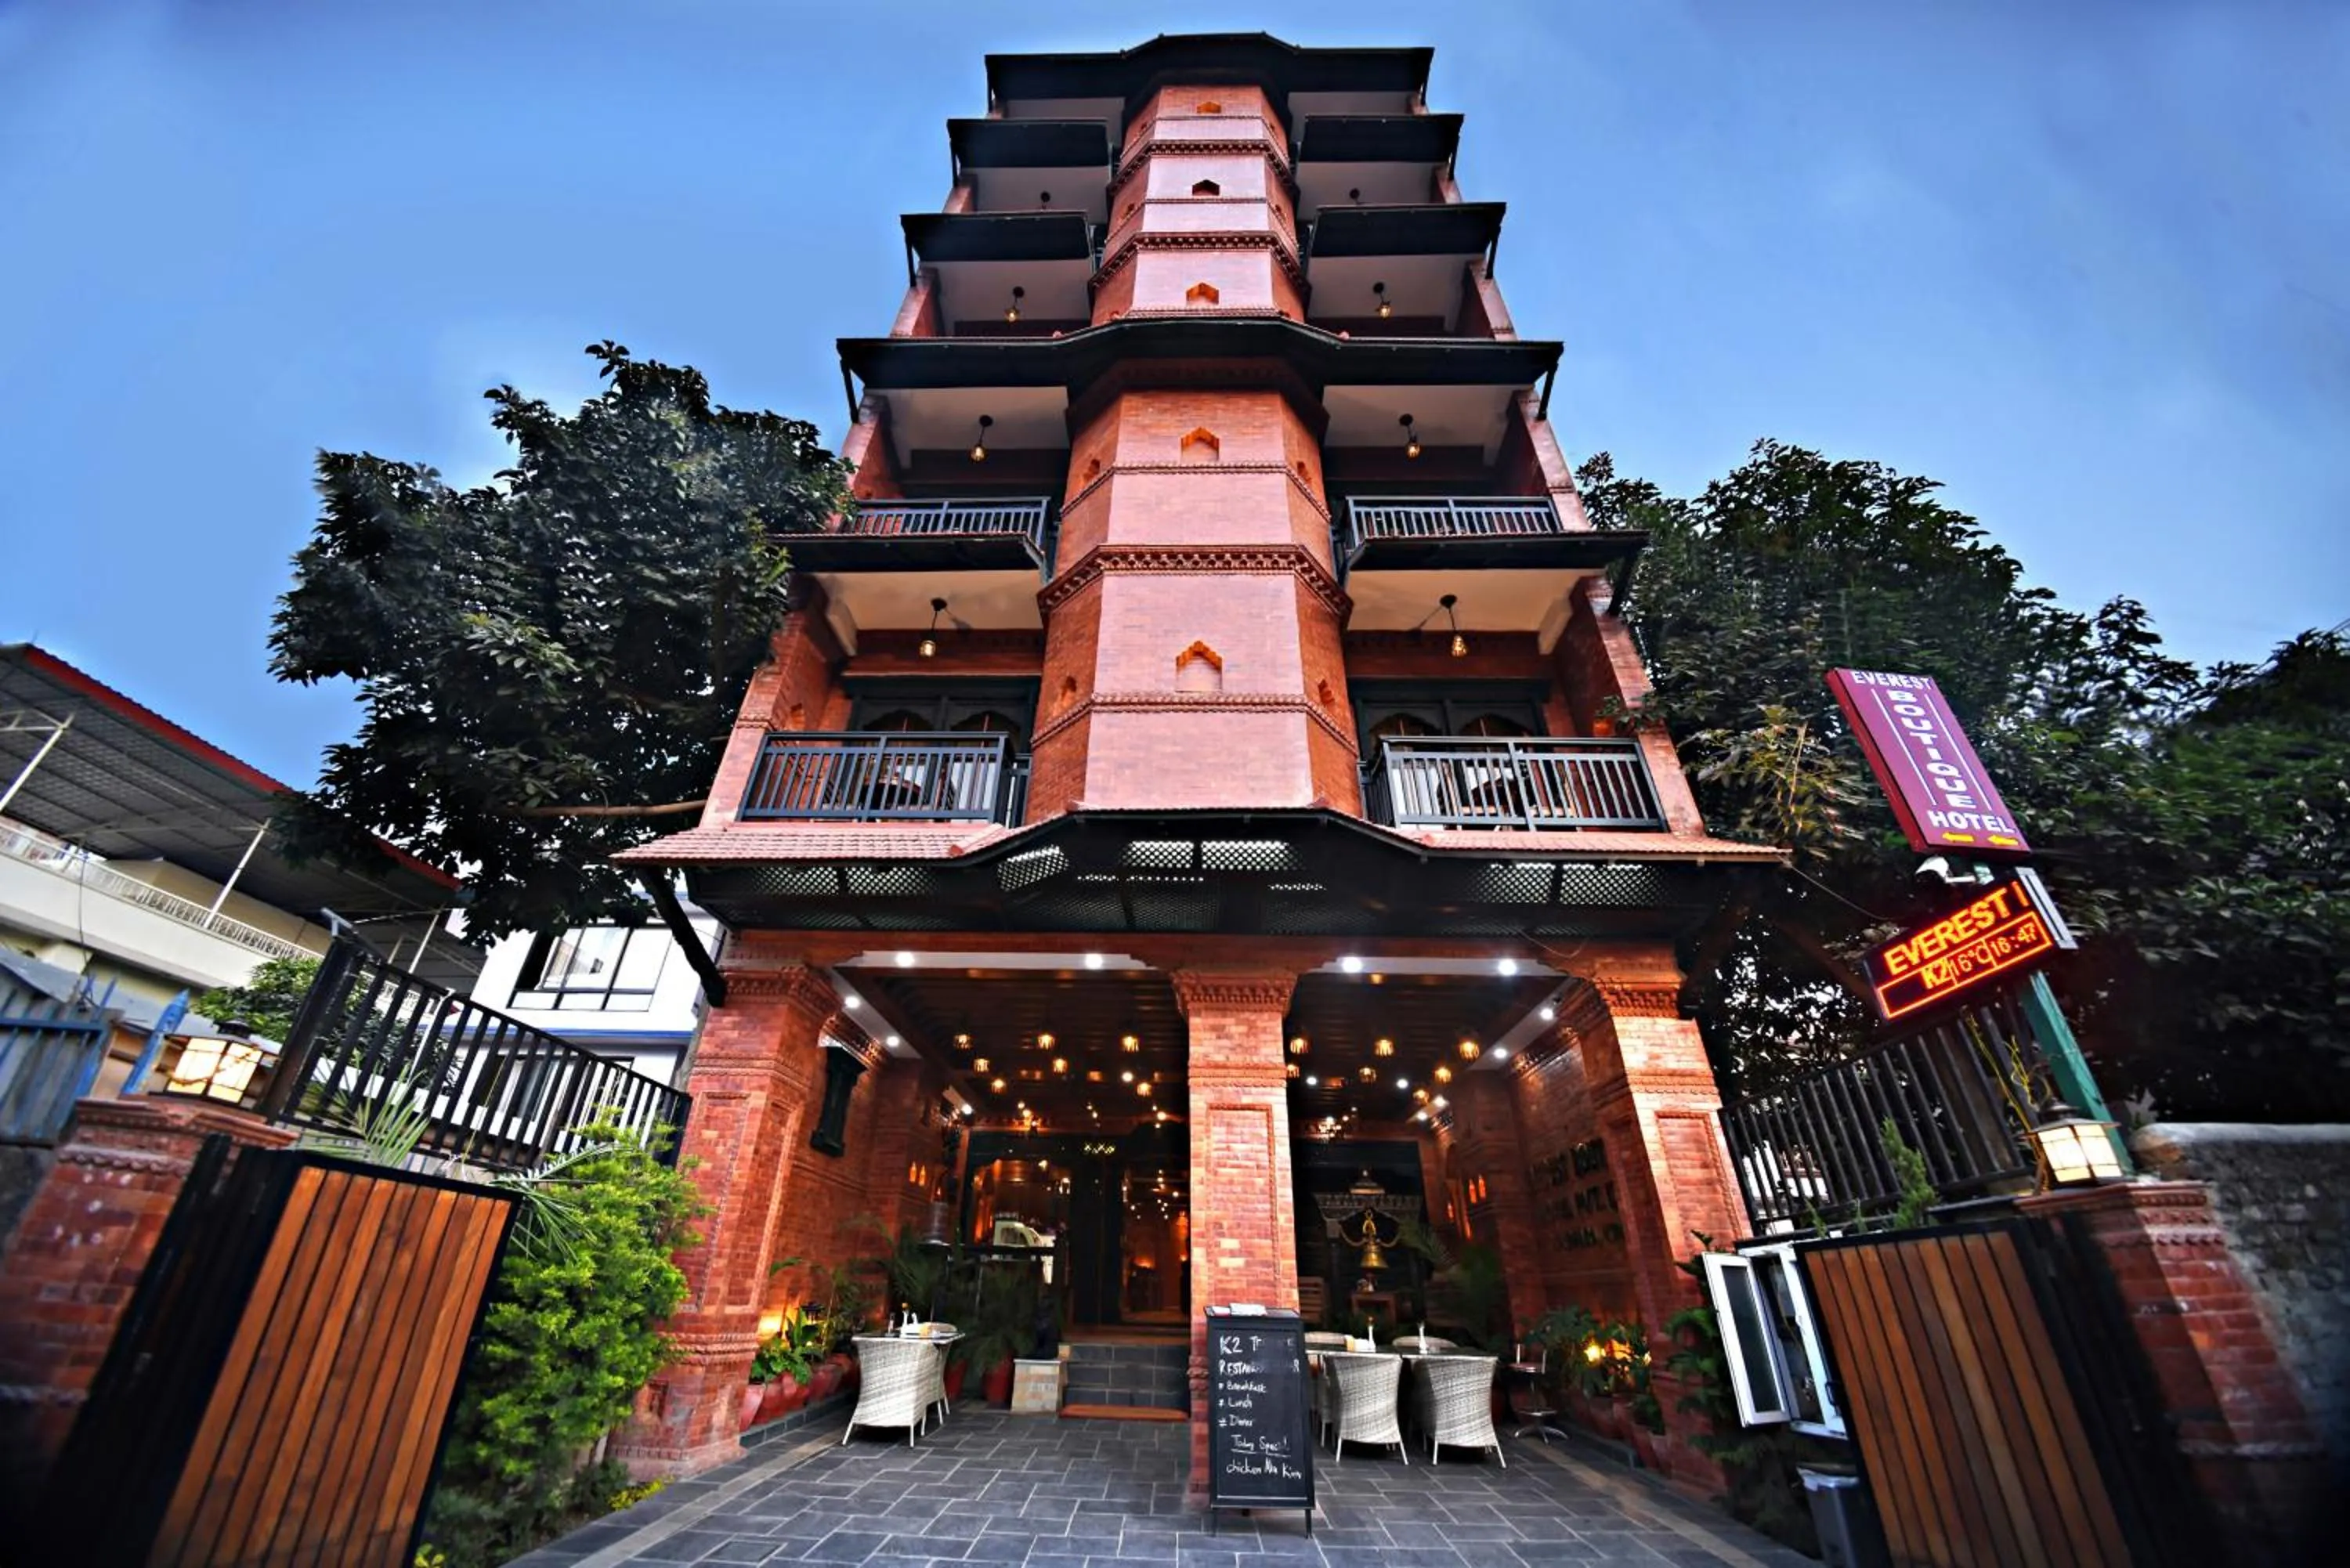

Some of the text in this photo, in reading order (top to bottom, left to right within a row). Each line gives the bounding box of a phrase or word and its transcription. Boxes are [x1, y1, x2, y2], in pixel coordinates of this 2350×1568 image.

[1851, 671, 1932, 690] EVEREST
[1886, 690, 1976, 808] BOUTIQUE
[1926, 810, 2015, 833] HOTEL
[1884, 887, 2011, 976] EVEREST
[1220, 1335, 1243, 1355] K2
